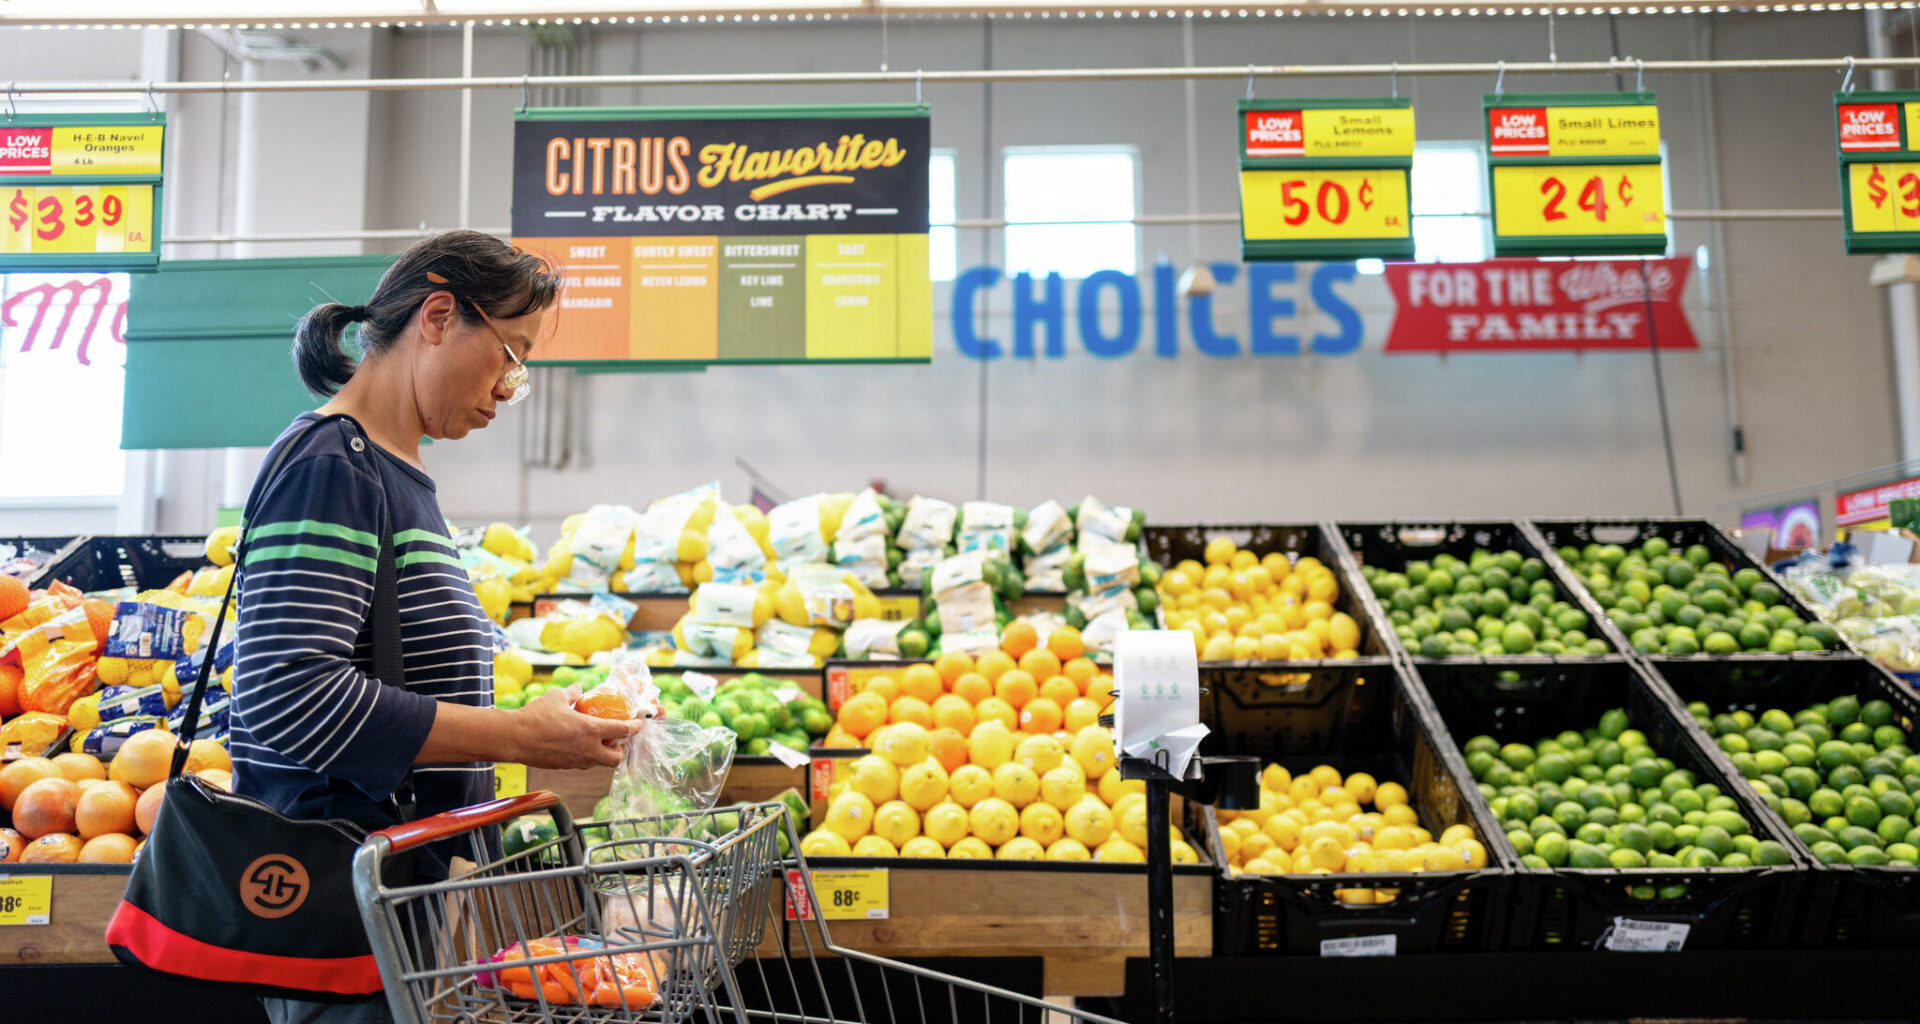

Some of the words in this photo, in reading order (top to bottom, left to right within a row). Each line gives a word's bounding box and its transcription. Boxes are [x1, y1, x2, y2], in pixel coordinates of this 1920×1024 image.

[1340, 116, 1381, 125] Small
[1501, 114, 1536, 127] LOW
[1849, 111, 1885, 123] LOW
[1257, 118, 1293, 130] LOW
[1559, 119, 1602, 129] Small
[1608, 118, 1656, 129] Limes
[1842, 123, 1895, 135] PRICES
[1250, 130, 1302, 142] PRICES
[1333, 126, 1393, 136] Lemons
[1494, 126, 1546, 139] PRICES
[7, 135, 41, 147] LOW
[73, 134, 105, 142] H-E-B
[110, 133, 144, 142] Navel
[0, 147, 49, 159] PRICES
[84, 143, 135, 153] Oranges
[546, 136, 691, 196] CITRUS
[697, 133, 907, 189] Flavorites
[592, 204, 725, 223] FLAVOR
[735, 203, 852, 221] CHART
[569, 245, 606, 259] SWEET
[634, 245, 675, 258] SUBTLY
[677, 244, 714, 257] SWEET
[724, 244, 800, 257] BITTERSWEET
[584, 275, 622, 288] ORANGE
[675, 275, 707, 287] LEMON
[740, 274, 759, 286] KEY
[761, 274, 784, 286] LIME
[1407, 269, 1478, 307] FOR
[1483, 267, 1553, 306] THE
[750, 296, 773, 308] LIME
[952, 262, 1365, 360] CHOICES
[1447, 312, 1641, 341] FAMILY
